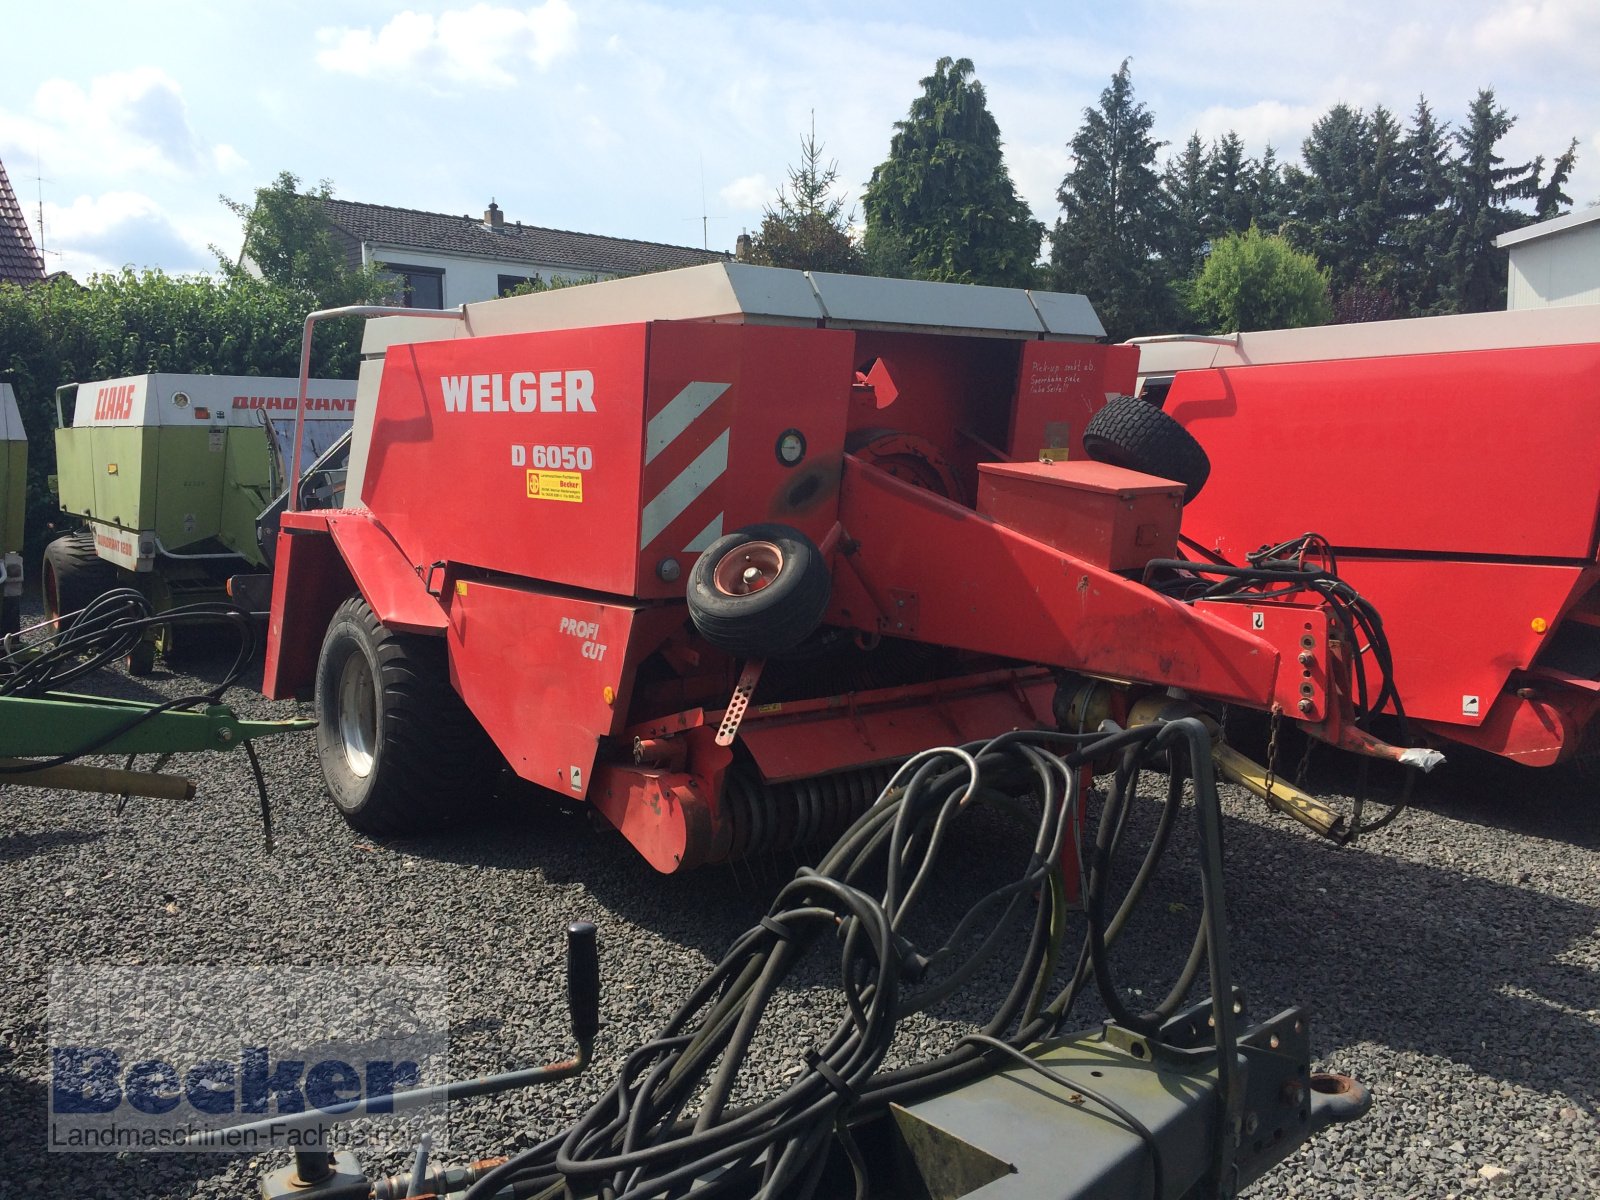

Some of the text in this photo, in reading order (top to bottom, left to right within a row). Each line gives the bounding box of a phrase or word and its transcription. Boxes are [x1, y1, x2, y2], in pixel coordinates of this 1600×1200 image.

[95, 384, 136, 421] CLAAS
[440, 370, 596, 413] WELGER
[232, 397, 356, 412] QUADRANT
[511, 444, 592, 470] D 6050
[559, 480, 579, 488] Becker
[559, 617, 599, 641] PROFI
[581, 642, 607, 661] CUT
